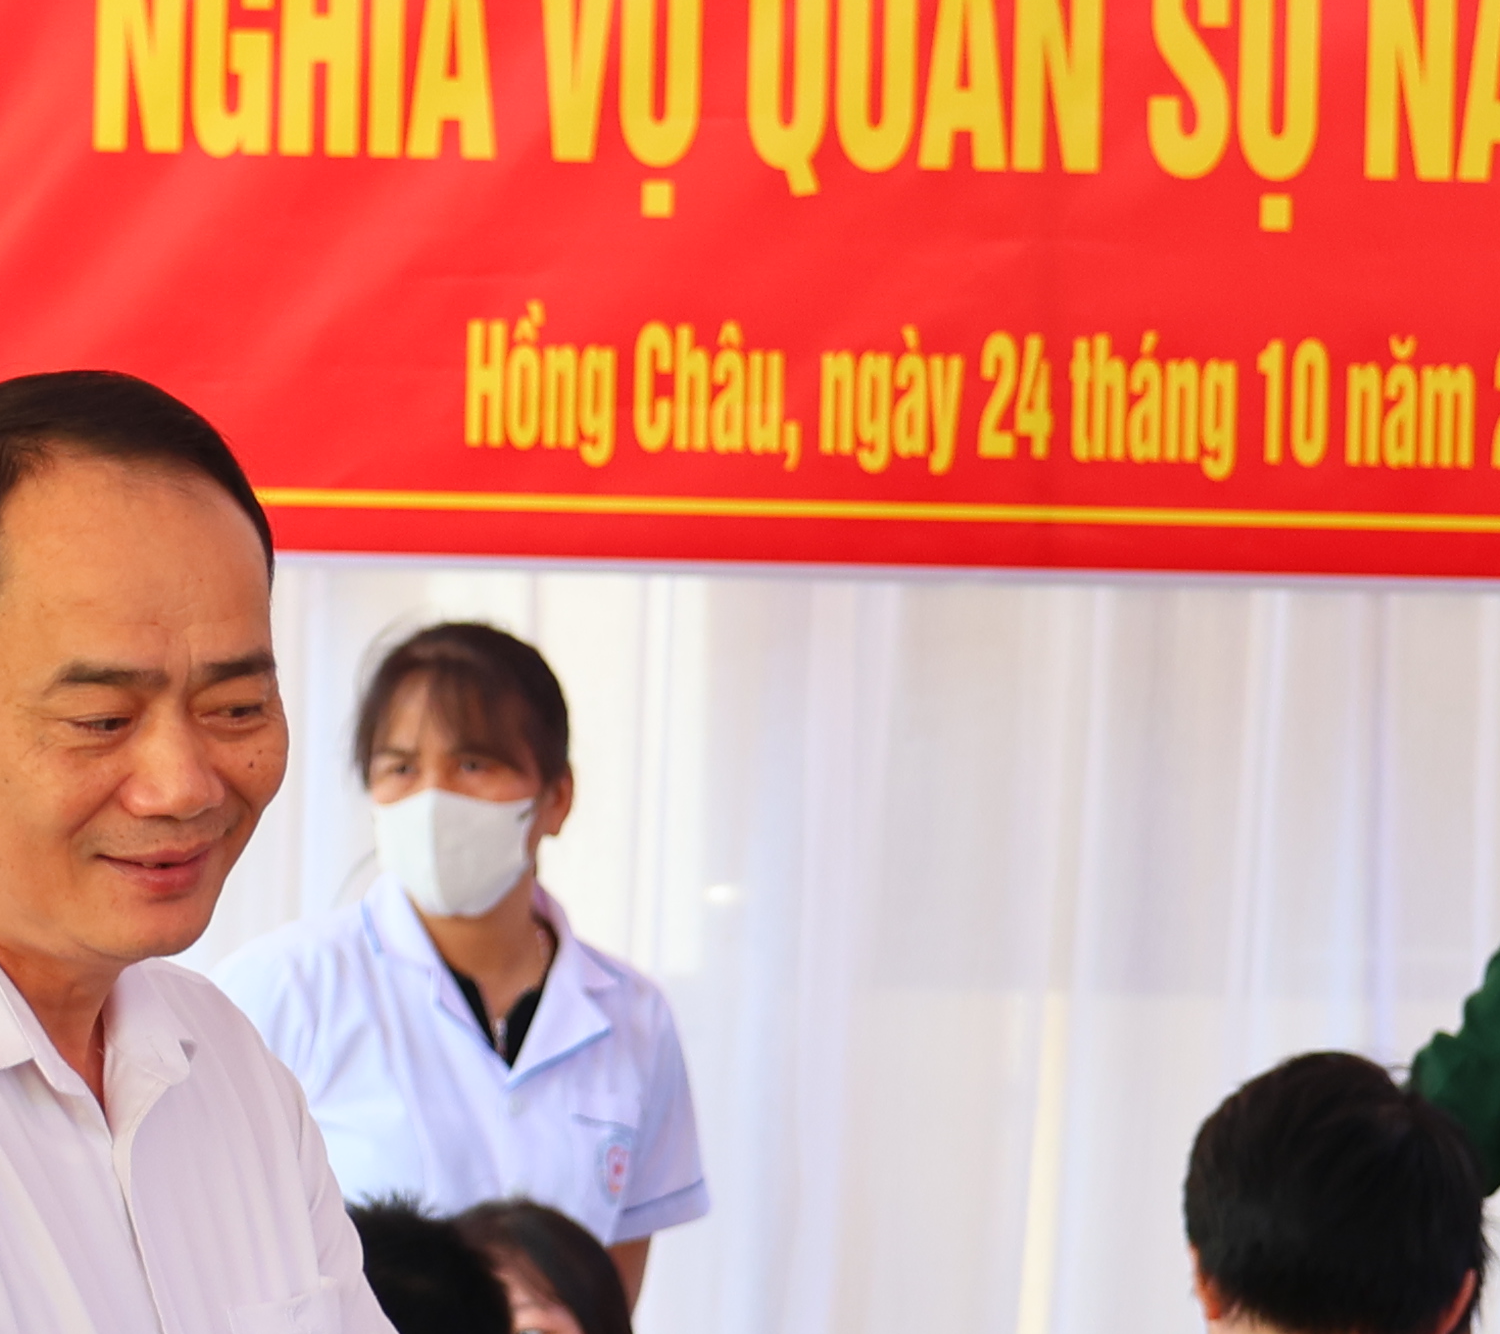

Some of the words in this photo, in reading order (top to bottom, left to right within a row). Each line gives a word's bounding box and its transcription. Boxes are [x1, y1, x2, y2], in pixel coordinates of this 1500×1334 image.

[465, 300, 615, 466] Hồng
[634, 322, 799, 467] Châu,
[820, 326, 963, 472] ngày
[979, 333, 1052, 457] 24
[1071, 332, 1236, 479] tháng
[1259, 340, 1328, 465] 10
[1347, 339, 1474, 466] năm
